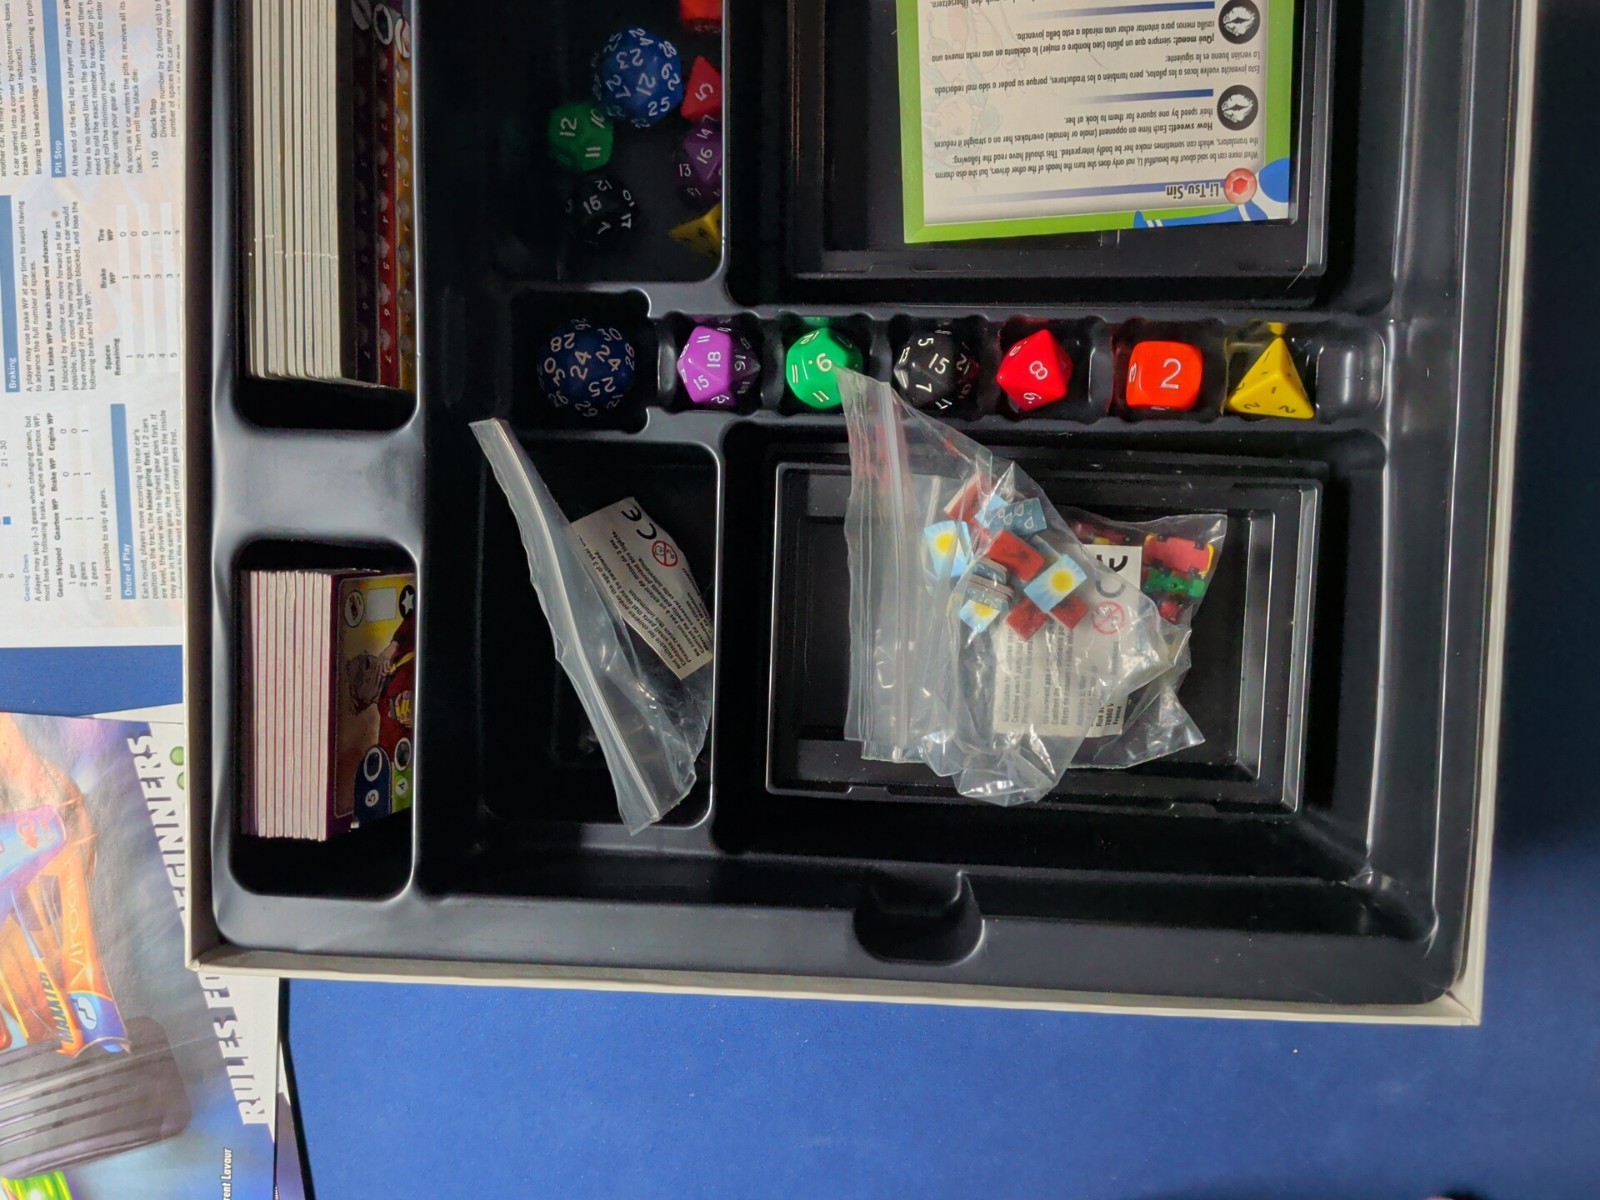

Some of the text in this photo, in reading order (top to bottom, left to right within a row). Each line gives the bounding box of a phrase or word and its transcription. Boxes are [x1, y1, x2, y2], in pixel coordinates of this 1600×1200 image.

[67, 56, 75, 78] player
[68, 86, 76, 98] lap
[606, 74, 632, 100] 27
[636, 72, 656, 96] 21
[695, 83, 714, 102] 5
[648, 96, 670, 117] 25
[150, 98, 159, 138] Quick Stop
[560, 117, 578, 137] 12
[1196, 122, 1213, 130] How
[1014, 133, 1044, 142] overtakes
[1046, 130, 1069, 140] female)
[1079, 128, 1098, 138] (male
[1099, 126, 1127, 137] opponent
[1137, 126, 1152, 134] time
[1152, 125, 1167, 133] Each
[54, 140, 63, 159] Stop
[934, 140, 956, 148] reduces
[963, 136, 986, 146] straight
[696, 148, 712, 164] 16
[72, 168, 78, 177] At
[679, 164, 692, 178] 13
[1166, 183, 1219, 199] Li Tsu Sin
[583, 194, 602, 215] 16
[107, 229, 113, 241] WP
[41, 228, 49, 263] advanced.
[109, 272, 116, 284] WP
[46, 332, 53, 344] WP
[550, 332, 576, 352] 28
[696, 334, 710, 344] 11
[104, 345, 113, 370] Spaces
[113, 338, 122, 376] Remaining
[570, 351, 592, 381] 24
[595, 344, 622, 372] 24
[706, 351, 722, 368] 18
[928, 352, 950, 374] 15
[8, 358, 18, 389] Braking
[544, 358, 566, 387] 30
[1028, 360, 1049, 380] 8
[1160, 358, 1182, 390] 2
[588, 376, 616, 398] 25
[694, 374, 710, 390] 15
[916, 382, 932, 394] 7
[47, 413, 56, 451] Engine WP
[1, 440, 7, 450] 30
[2, 458, 8, 467] 21
[50, 458, 56, 469] WP
[52, 499, 59, 510] WP
[55, 548, 64, 575] Skipped
[123, 544, 132, 596] Order of Play
[23, 574, 32, 602] Gearing
[214, 1020, 267, 1124] RULES
[221, 1148, 232, 1180] Lavaur
